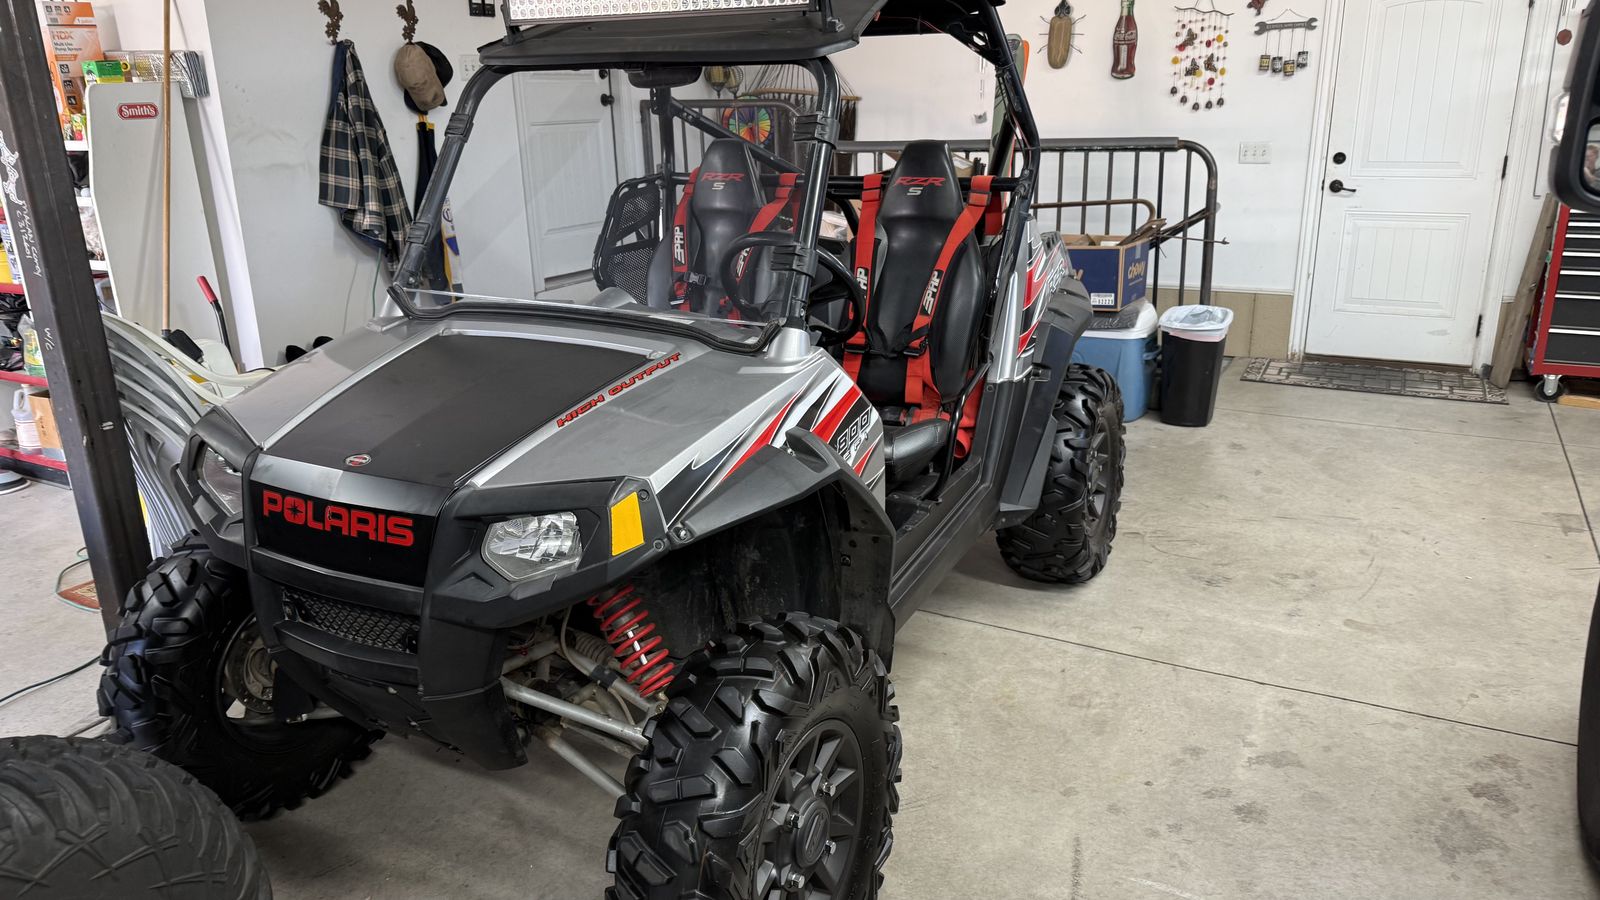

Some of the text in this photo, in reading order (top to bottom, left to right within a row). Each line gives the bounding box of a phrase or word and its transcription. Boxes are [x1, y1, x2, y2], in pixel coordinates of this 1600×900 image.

[121, 105, 156, 118] Smith's
[701, 172, 745, 182] RZR
[893, 176, 946, 187] RZR
[712, 182, 726, 190] S
[907, 187, 924, 196] S
[556, 352, 681, 428] HIGH OUTPUT
[836, 405, 872, 455] 800
[262, 489, 414, 547] POLARIS
